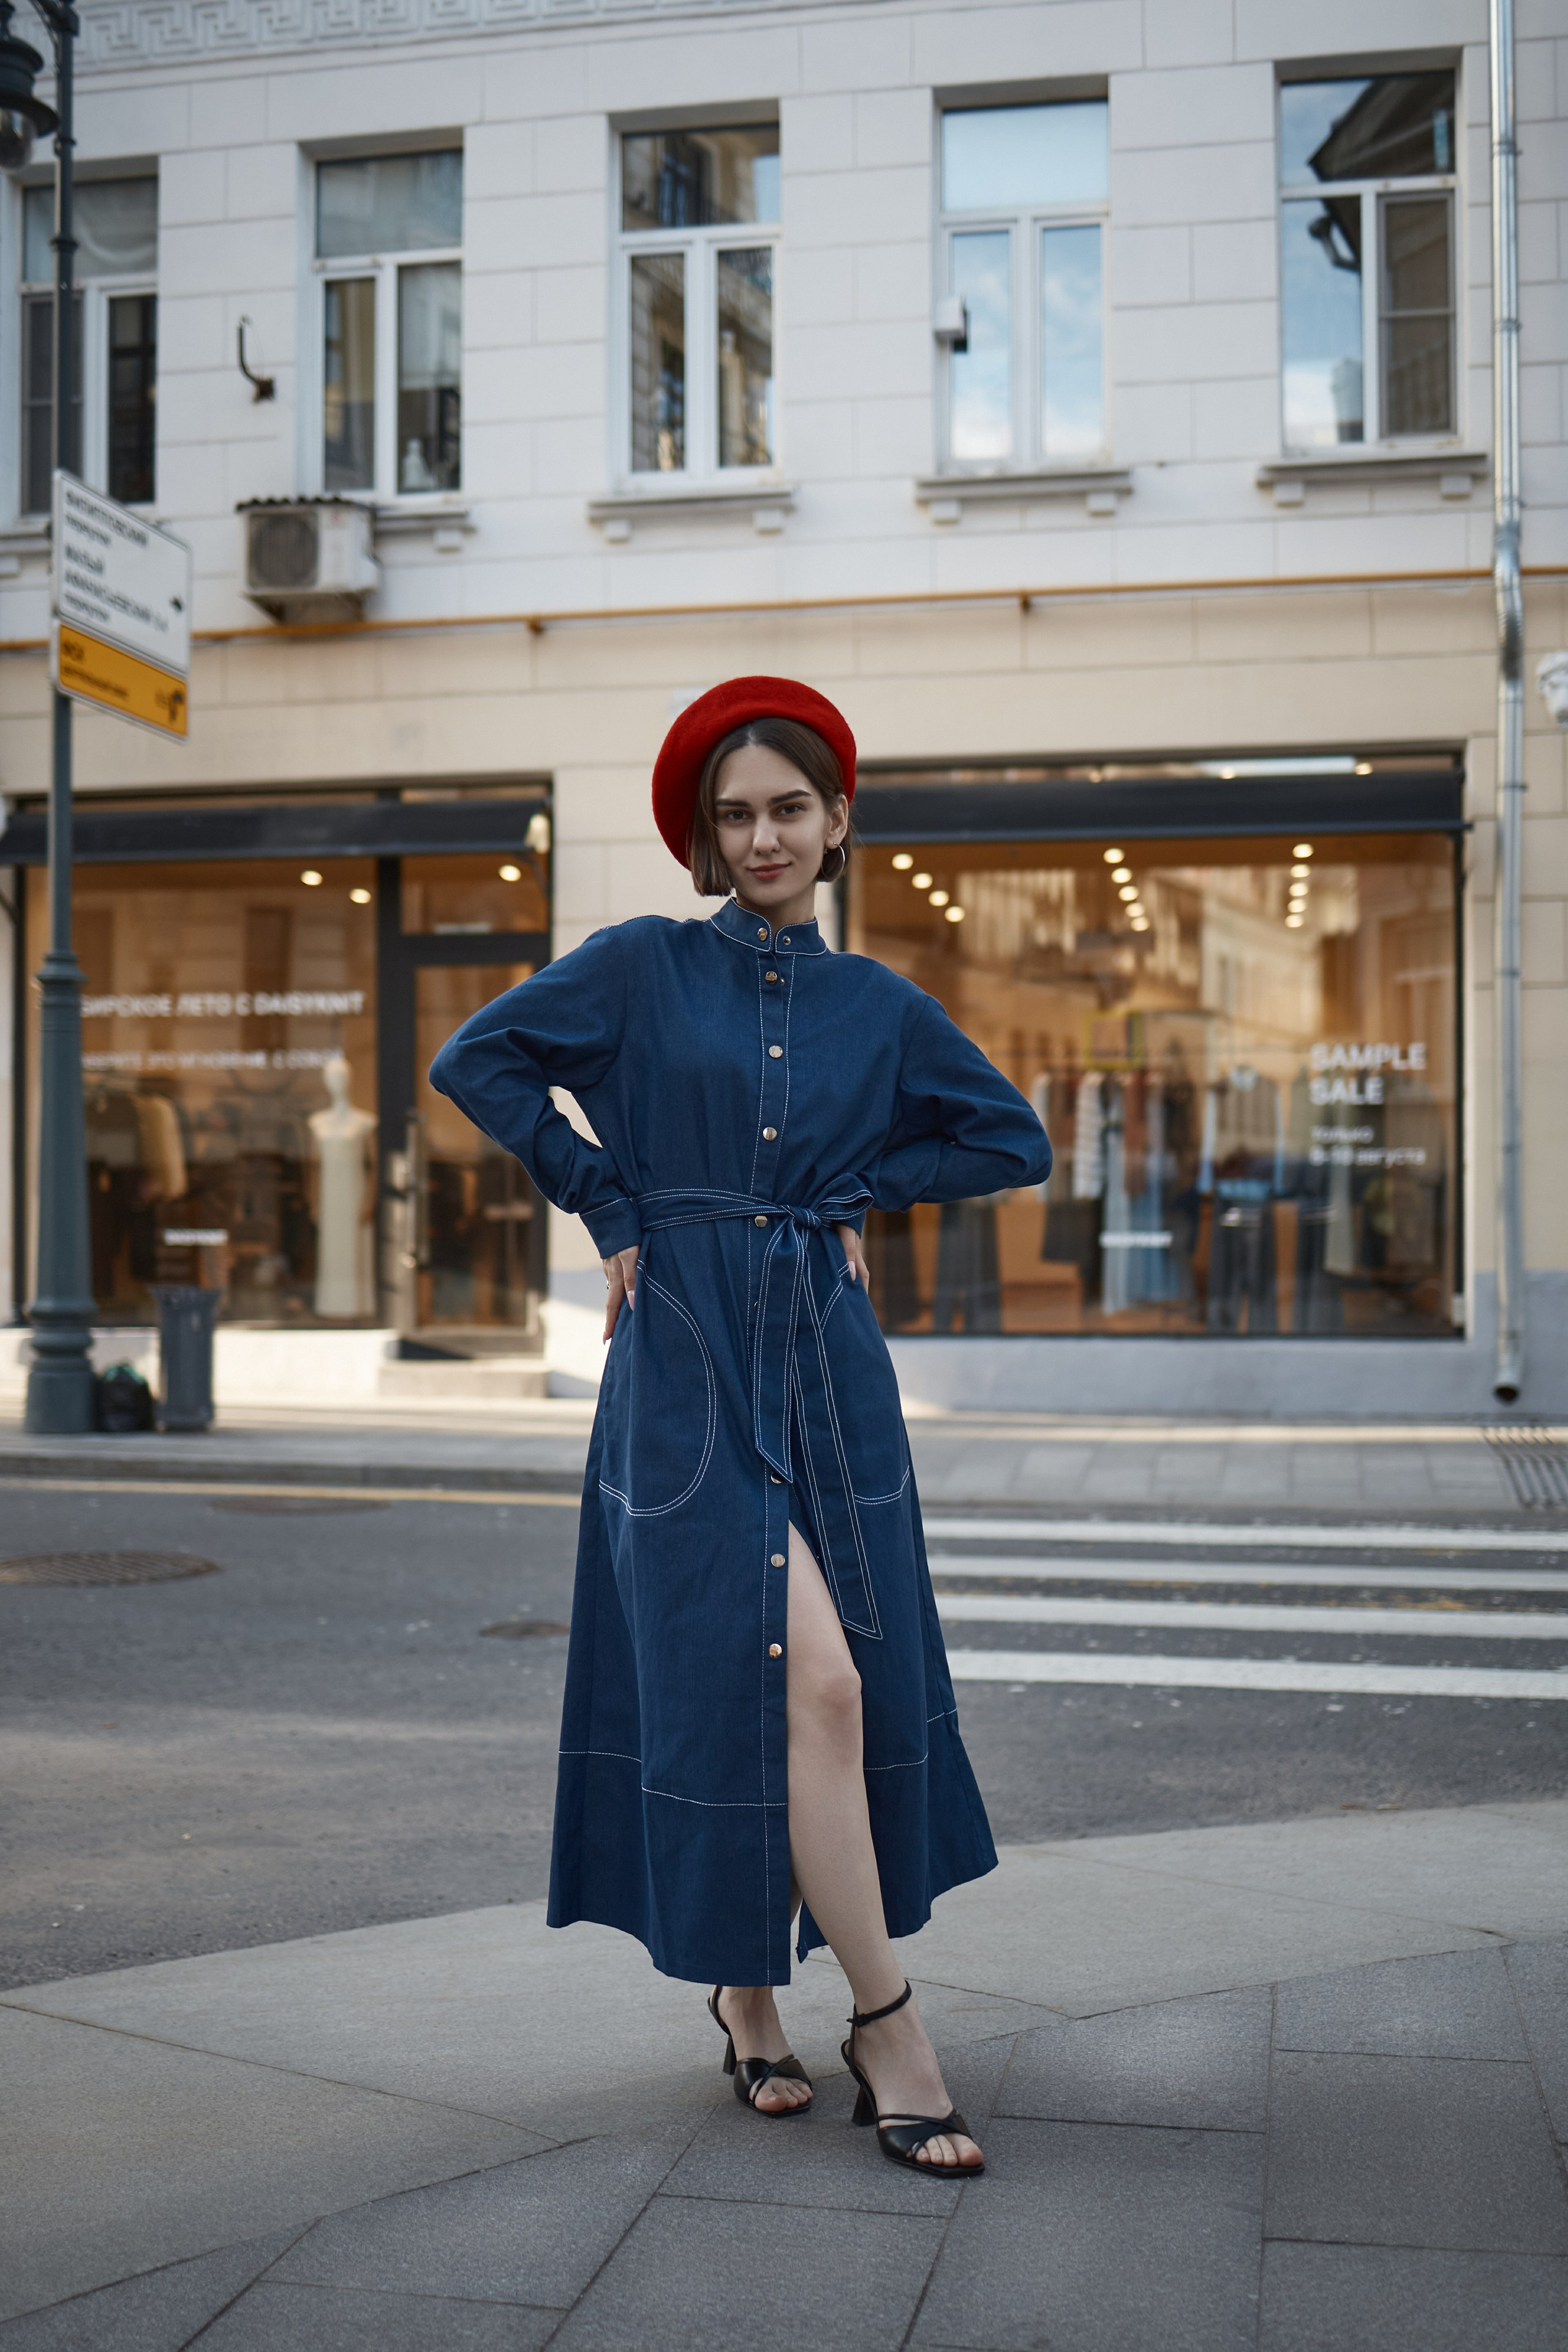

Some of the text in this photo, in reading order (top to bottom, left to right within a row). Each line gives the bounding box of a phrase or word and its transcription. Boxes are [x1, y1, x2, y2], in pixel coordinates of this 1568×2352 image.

[176, 992, 232, 1016] ЛЕТО
[1310, 1042, 1427, 1071] SAMPLE
[1310, 1076, 1384, 1106] SALE
[1355, 1147, 1426, 1169] августа
